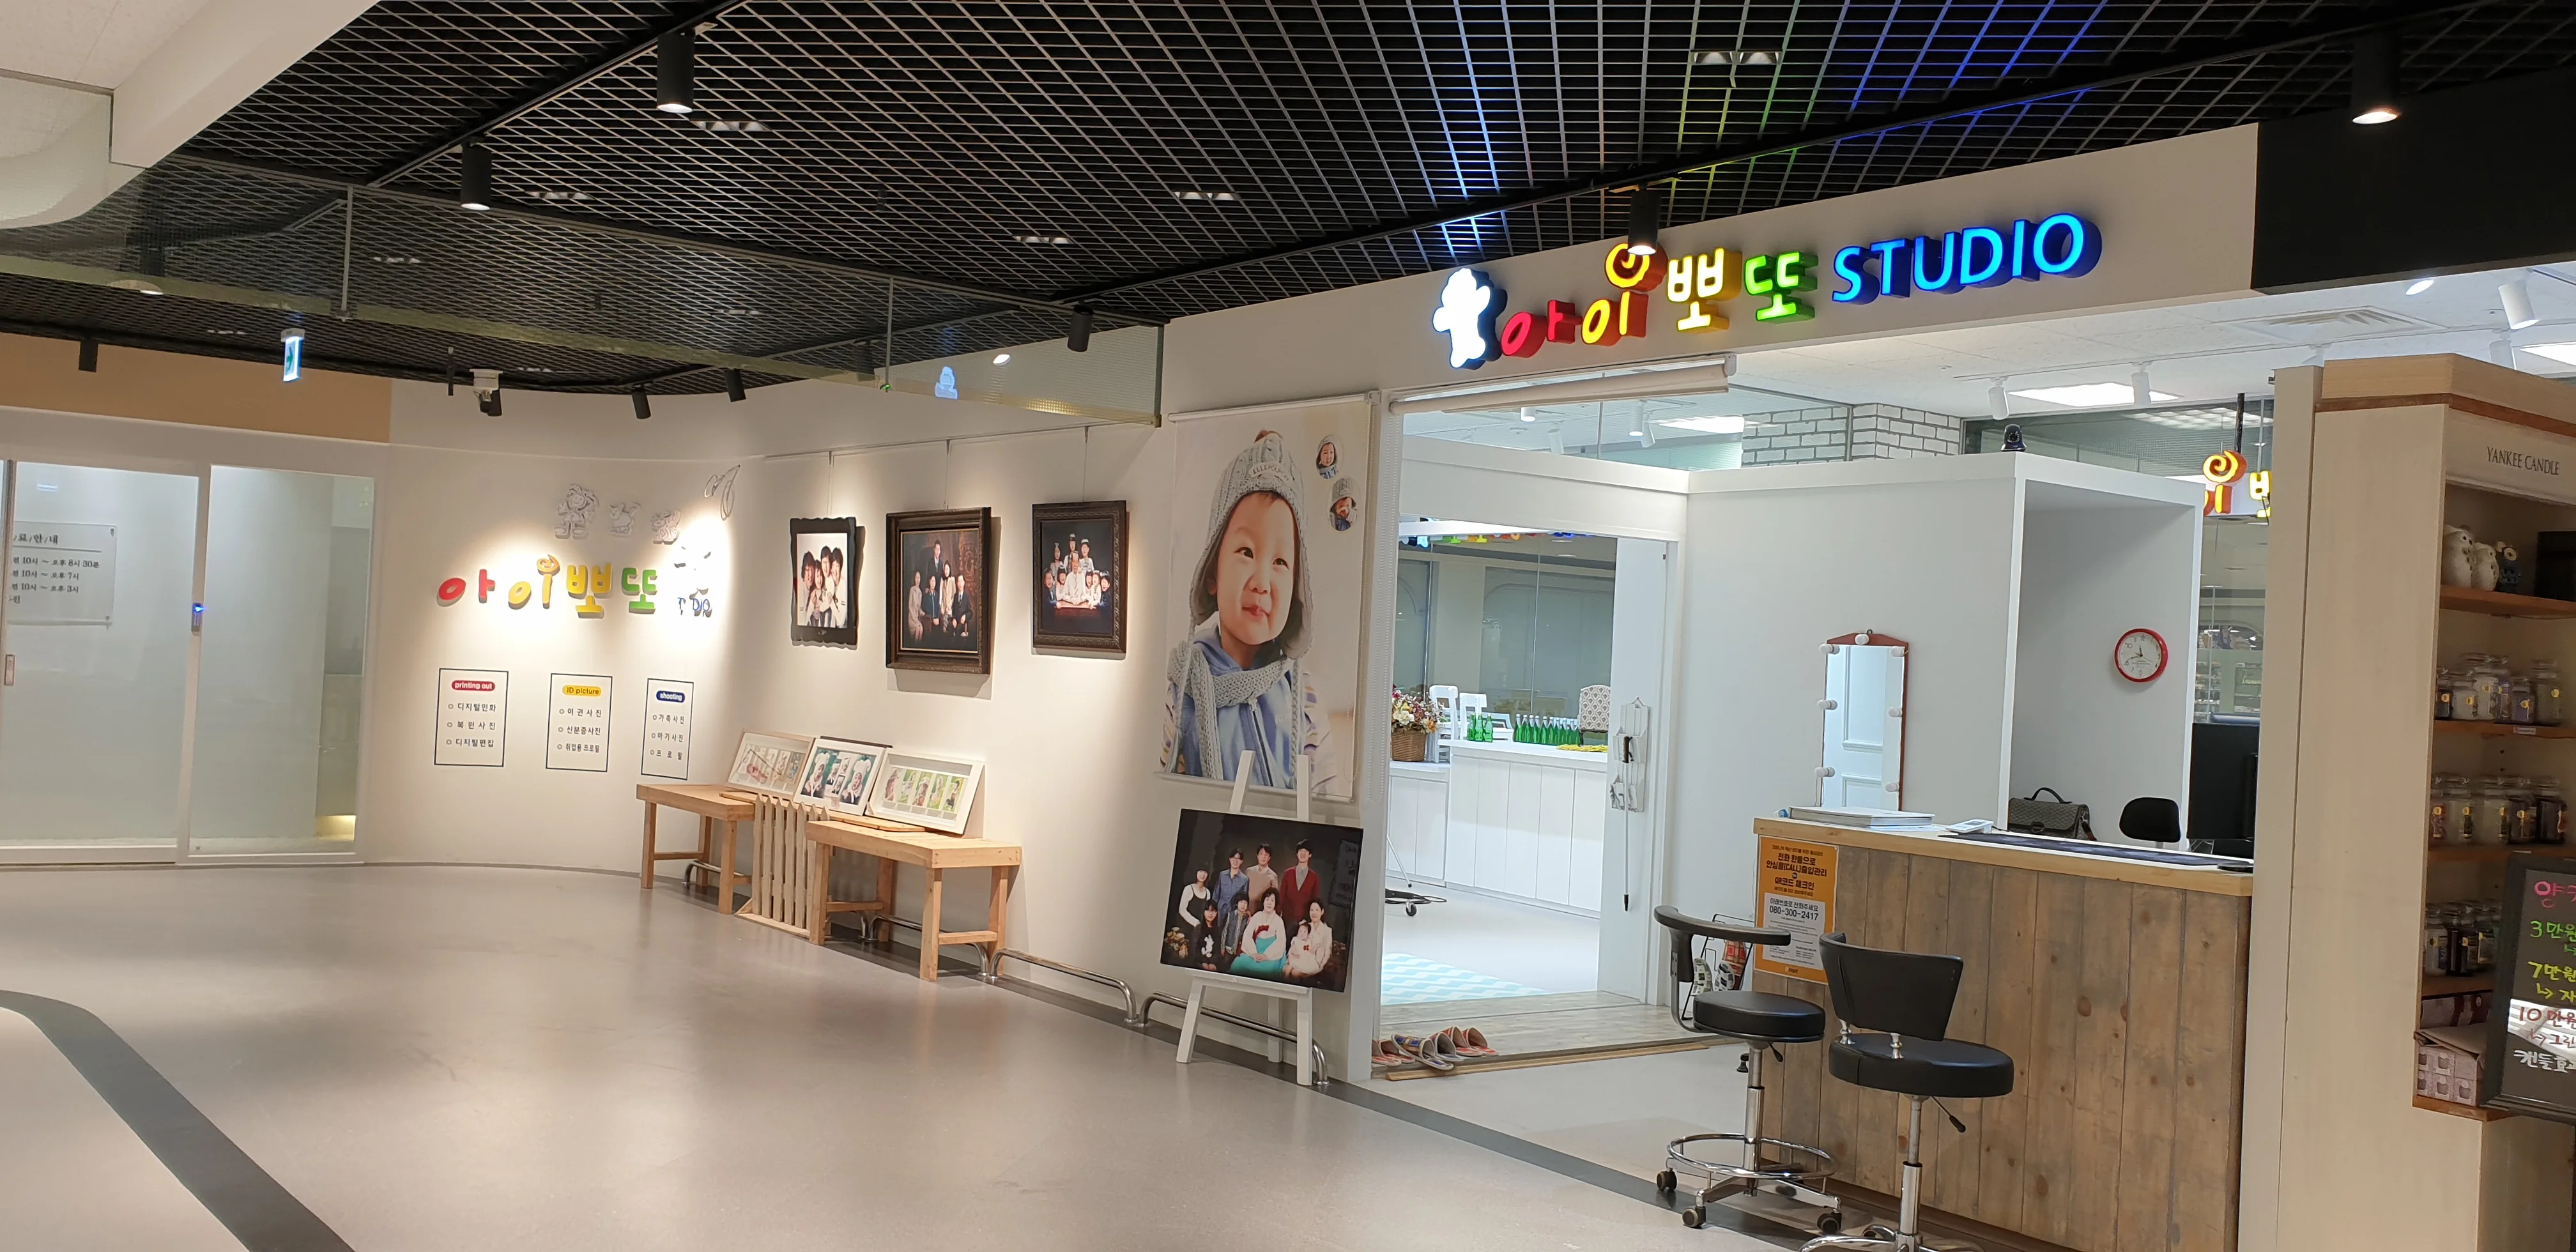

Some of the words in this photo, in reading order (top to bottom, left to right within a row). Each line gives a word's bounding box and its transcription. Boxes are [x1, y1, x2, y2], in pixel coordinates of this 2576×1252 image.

[1831, 213, 2099, 305] STUDIO
[2487, 446, 2522, 468] YANKEE
[2524, 455, 2559, 475] CANDLE
[659, 692, 682, 701] shooting
[457, 703, 496, 712] 디지털인화
[567, 726, 601, 735] 신분증사진
[456, 738, 494, 747] 디지털편집
[1778, 853, 1790, 862] 전화
[1769, 905, 1819, 920] 080-300-2417
